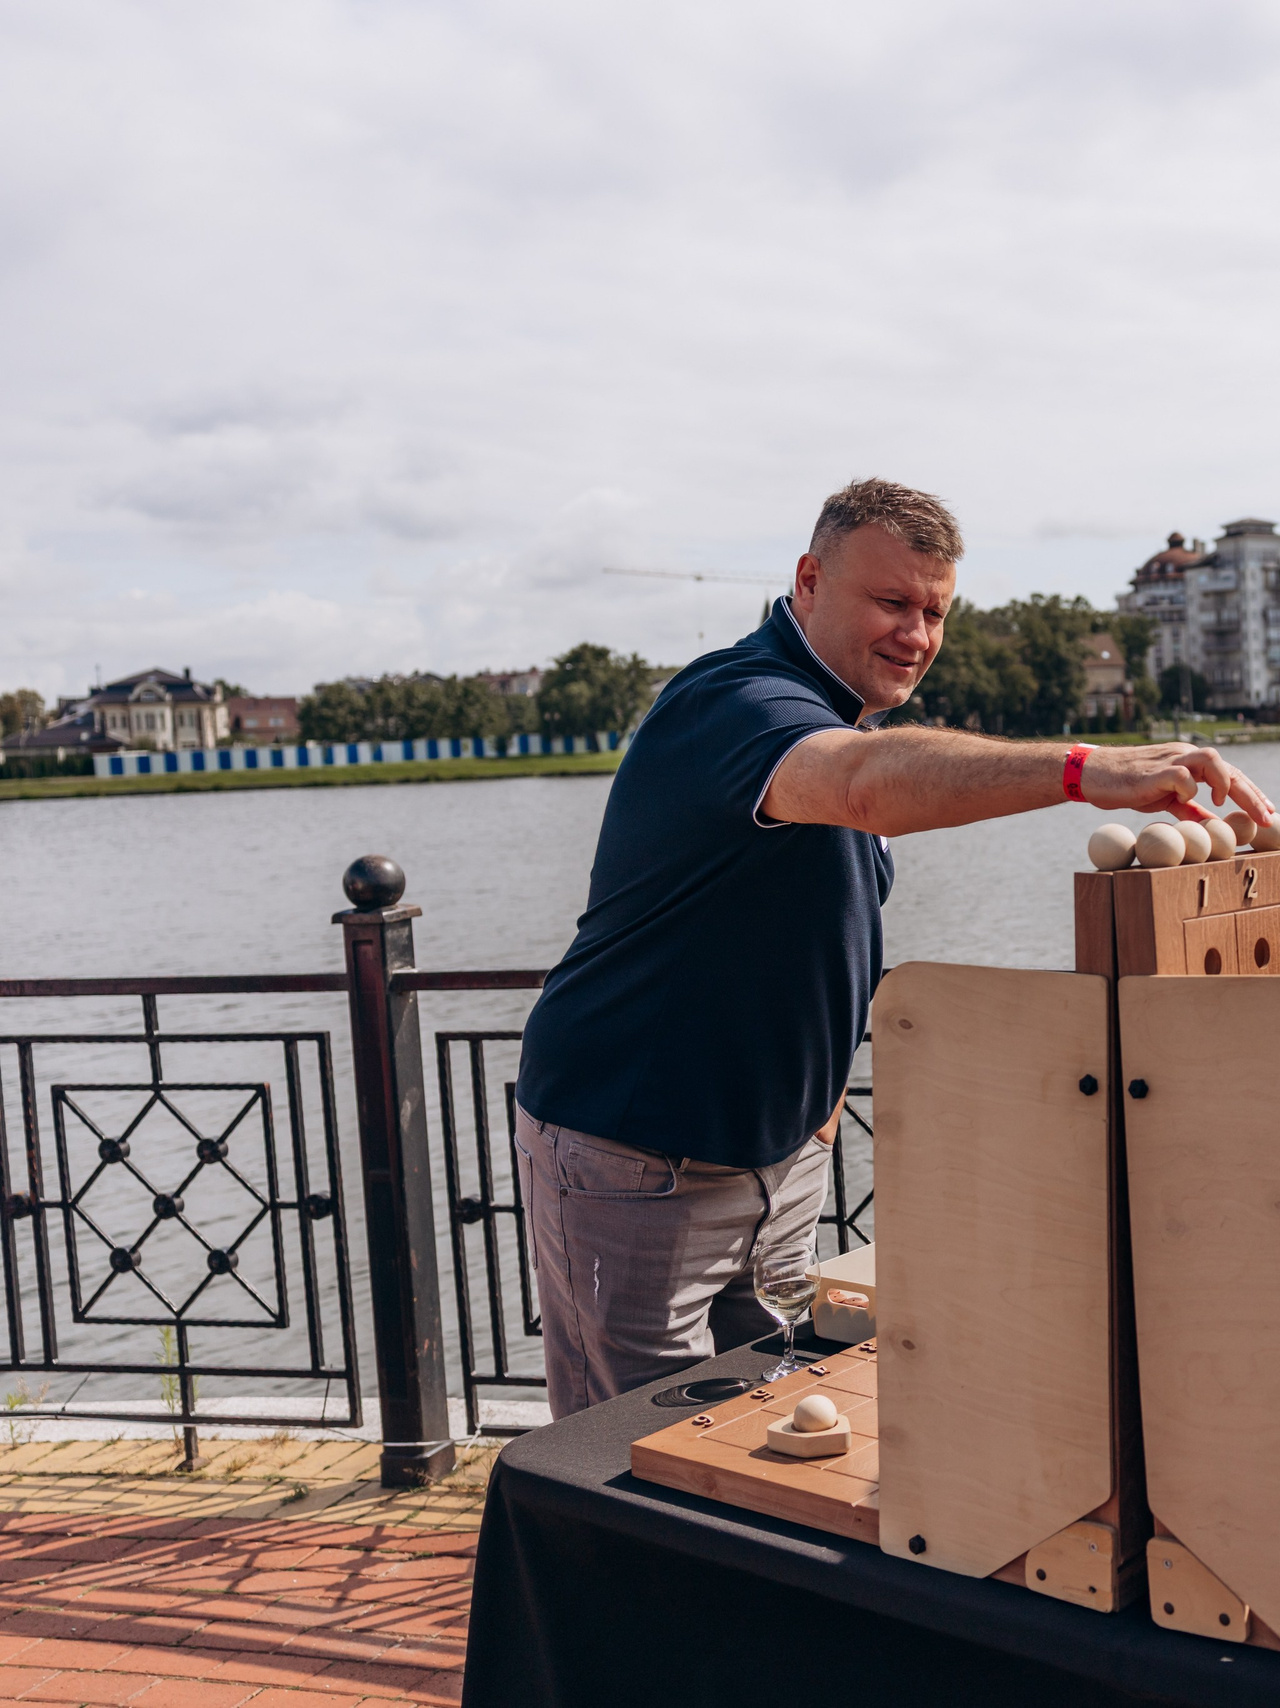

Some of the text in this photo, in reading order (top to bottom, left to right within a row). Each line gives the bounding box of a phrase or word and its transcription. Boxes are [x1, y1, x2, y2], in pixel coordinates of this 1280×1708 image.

[1246, 867, 1258, 899] 2
[808, 1365, 831, 1377] 4
[750, 1389, 775, 1402] 5
[692, 1414, 715, 1429] 6
